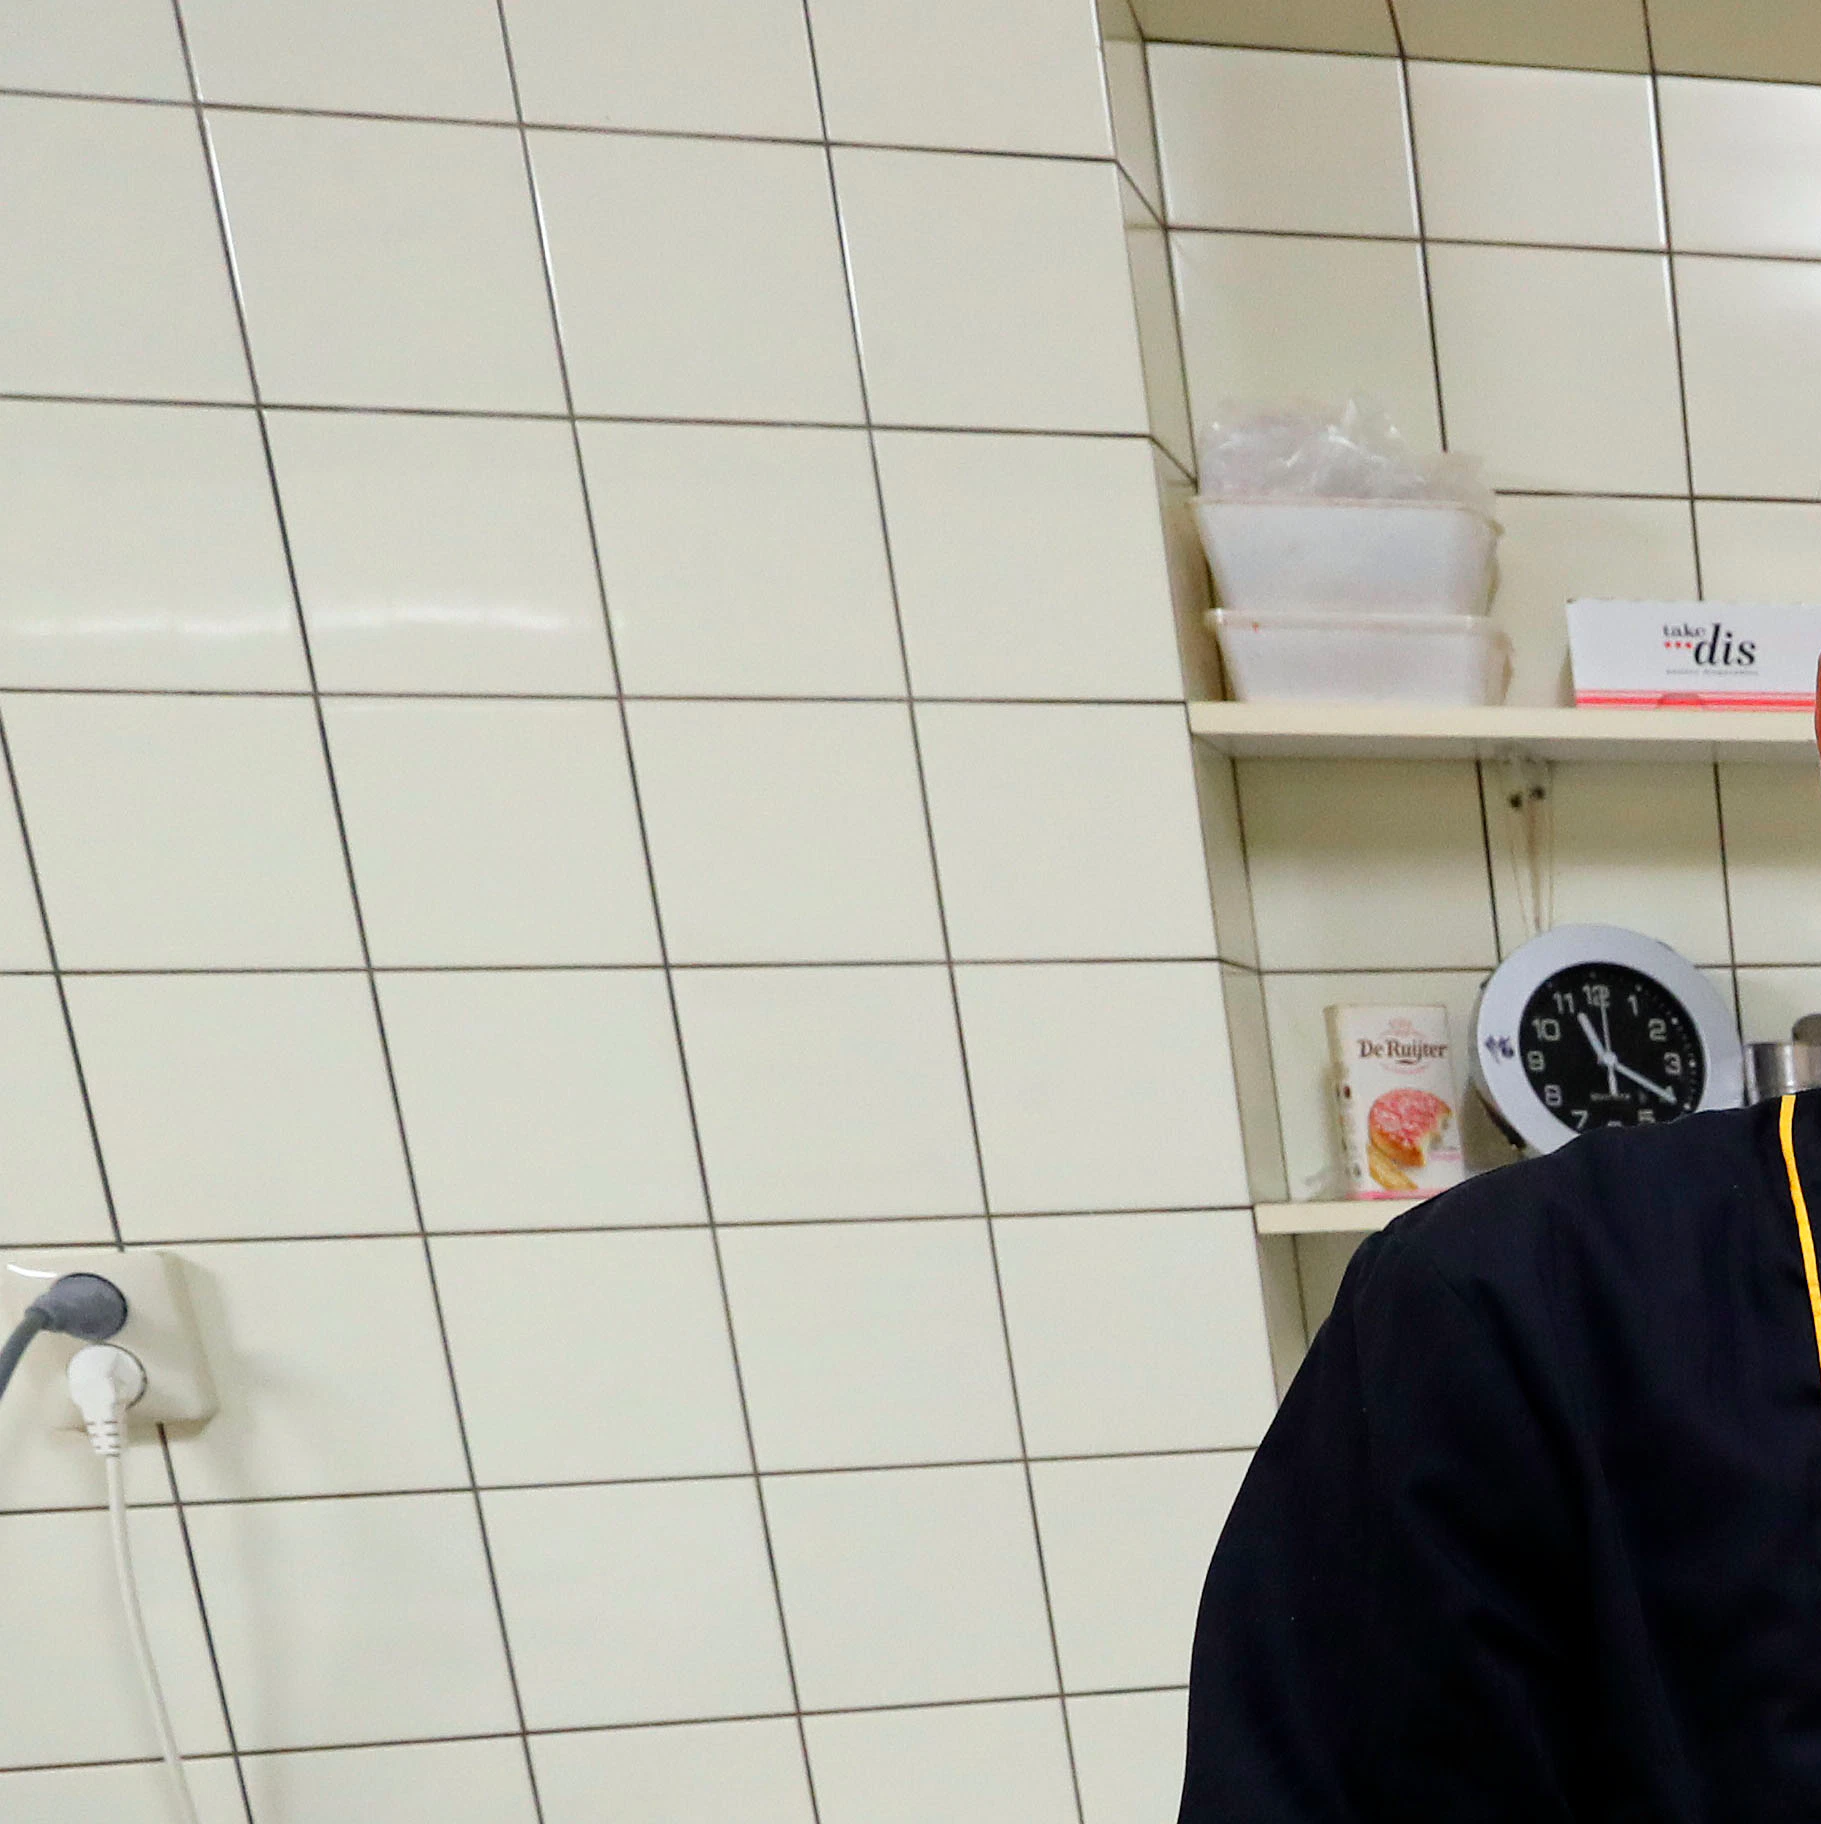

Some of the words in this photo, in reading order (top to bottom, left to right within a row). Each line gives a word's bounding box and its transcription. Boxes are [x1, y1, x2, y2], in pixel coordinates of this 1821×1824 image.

[1662, 622, 1706, 638] take
[1693, 622, 1756, 666] dis
[1553, 991, 1575, 1016] 11
[1582, 984, 1611, 1009] 12
[1628, 993, 1639, 1017] 1
[1532, 1017, 1561, 1042] 10
[1648, 1017, 1668, 1042] 2
[1357, 1037, 1384, 1059] De
[1385, 1037, 1450, 1062] Ruijter
[1526, 1050, 1545, 1073] 9
[1663, 1051, 1682, 1076] 3
[1543, 1083, 1563, 1108] 8
[1571, 1108, 1589, 1130] 7
